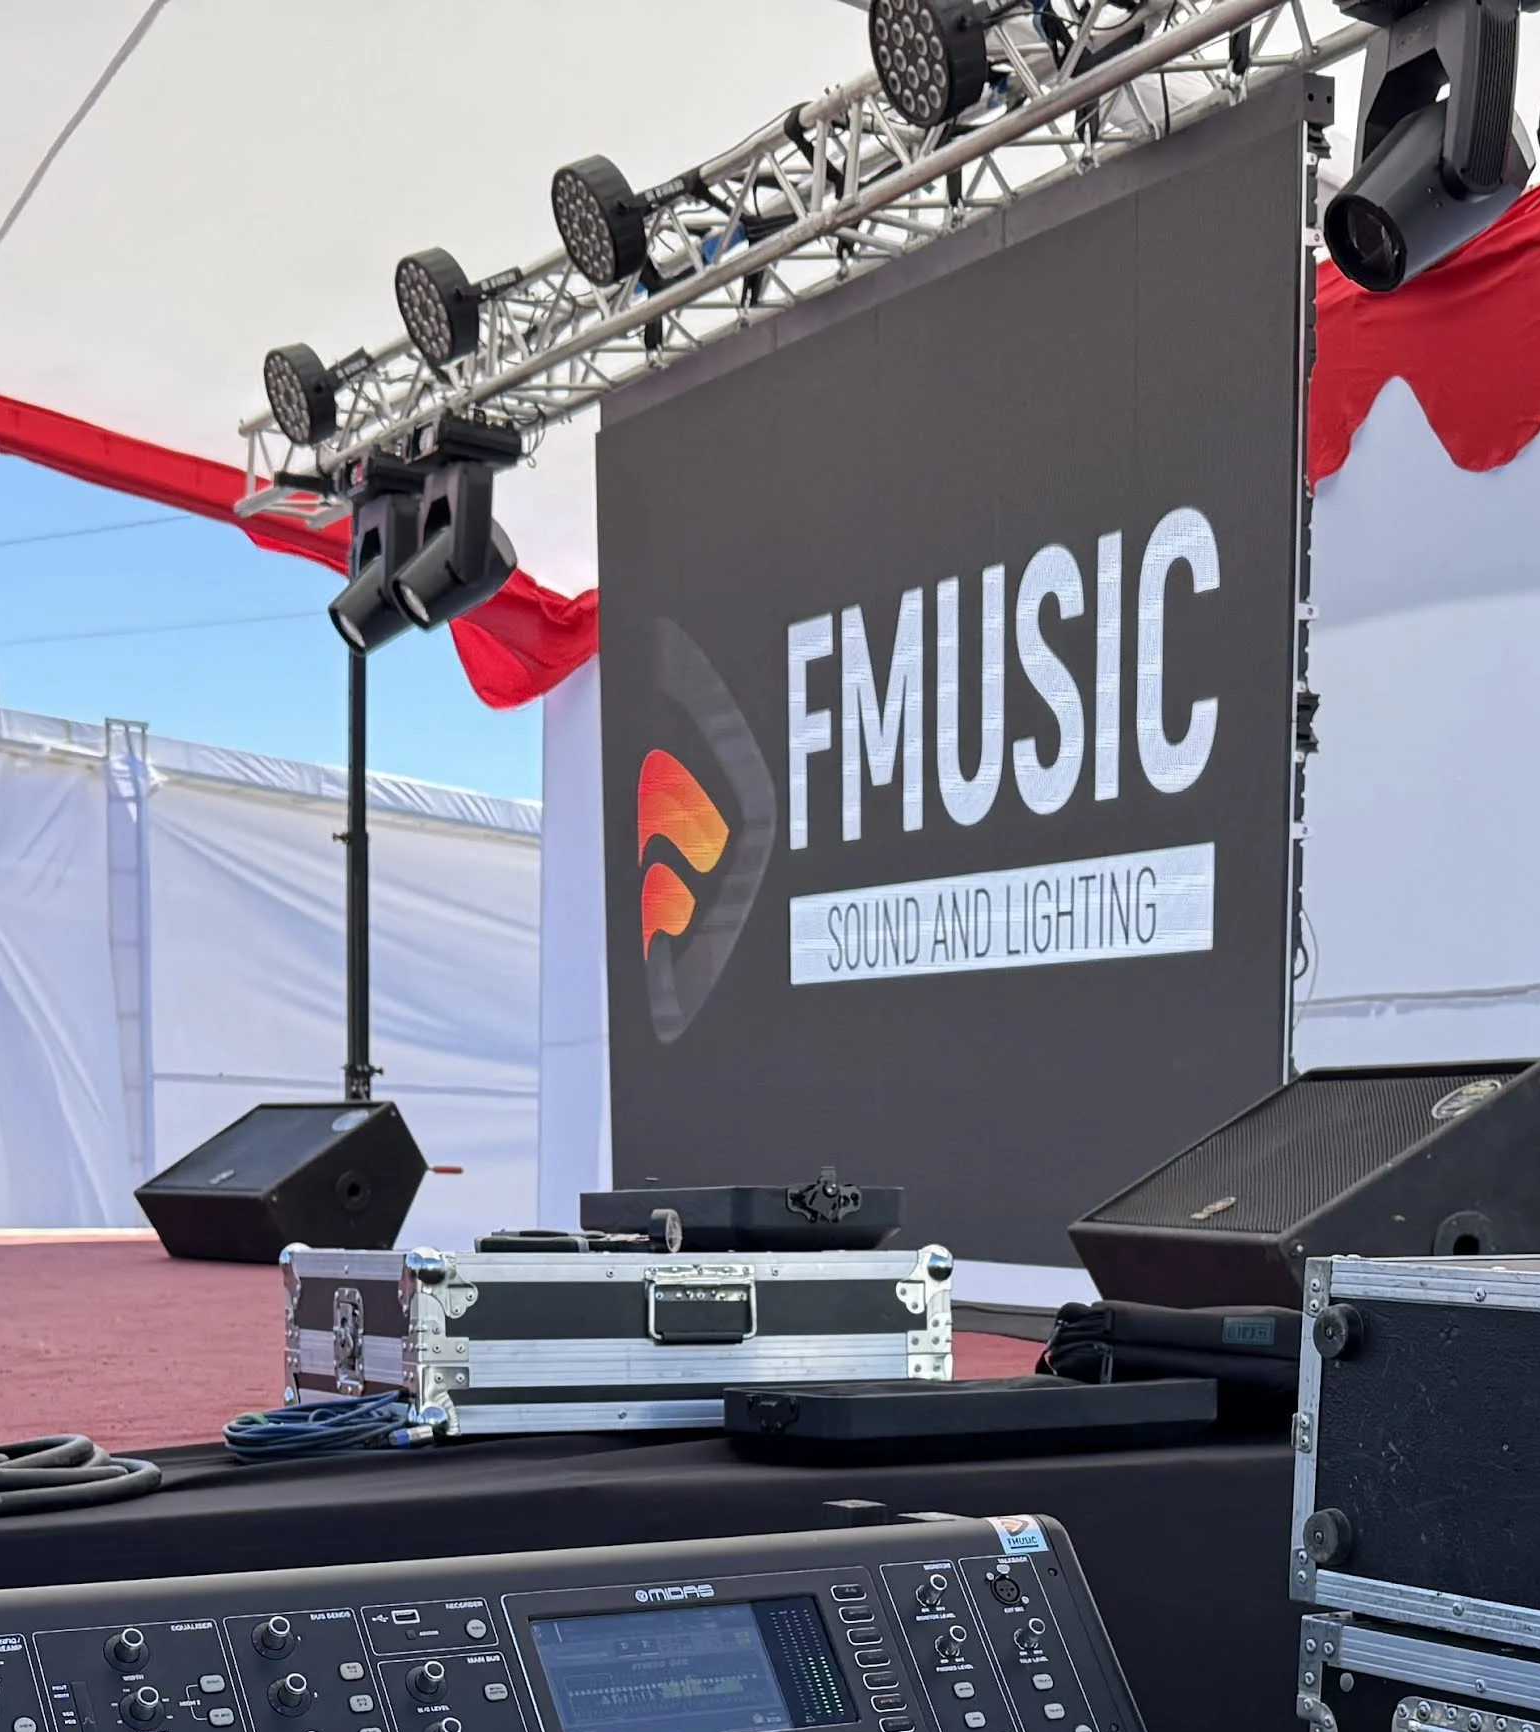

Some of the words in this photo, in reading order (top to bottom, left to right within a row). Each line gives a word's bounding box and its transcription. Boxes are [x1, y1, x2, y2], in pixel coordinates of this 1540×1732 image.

[788, 506, 1220, 849] FMUSIC
[827, 897, 921, 973] SOUND
[931, 888, 992, 963] AND
[1006, 867, 1157, 955] LIGHTING
[649, 1584, 715, 1602] MIDAS
[170, 1622, 213, 1632] EQUALISER
